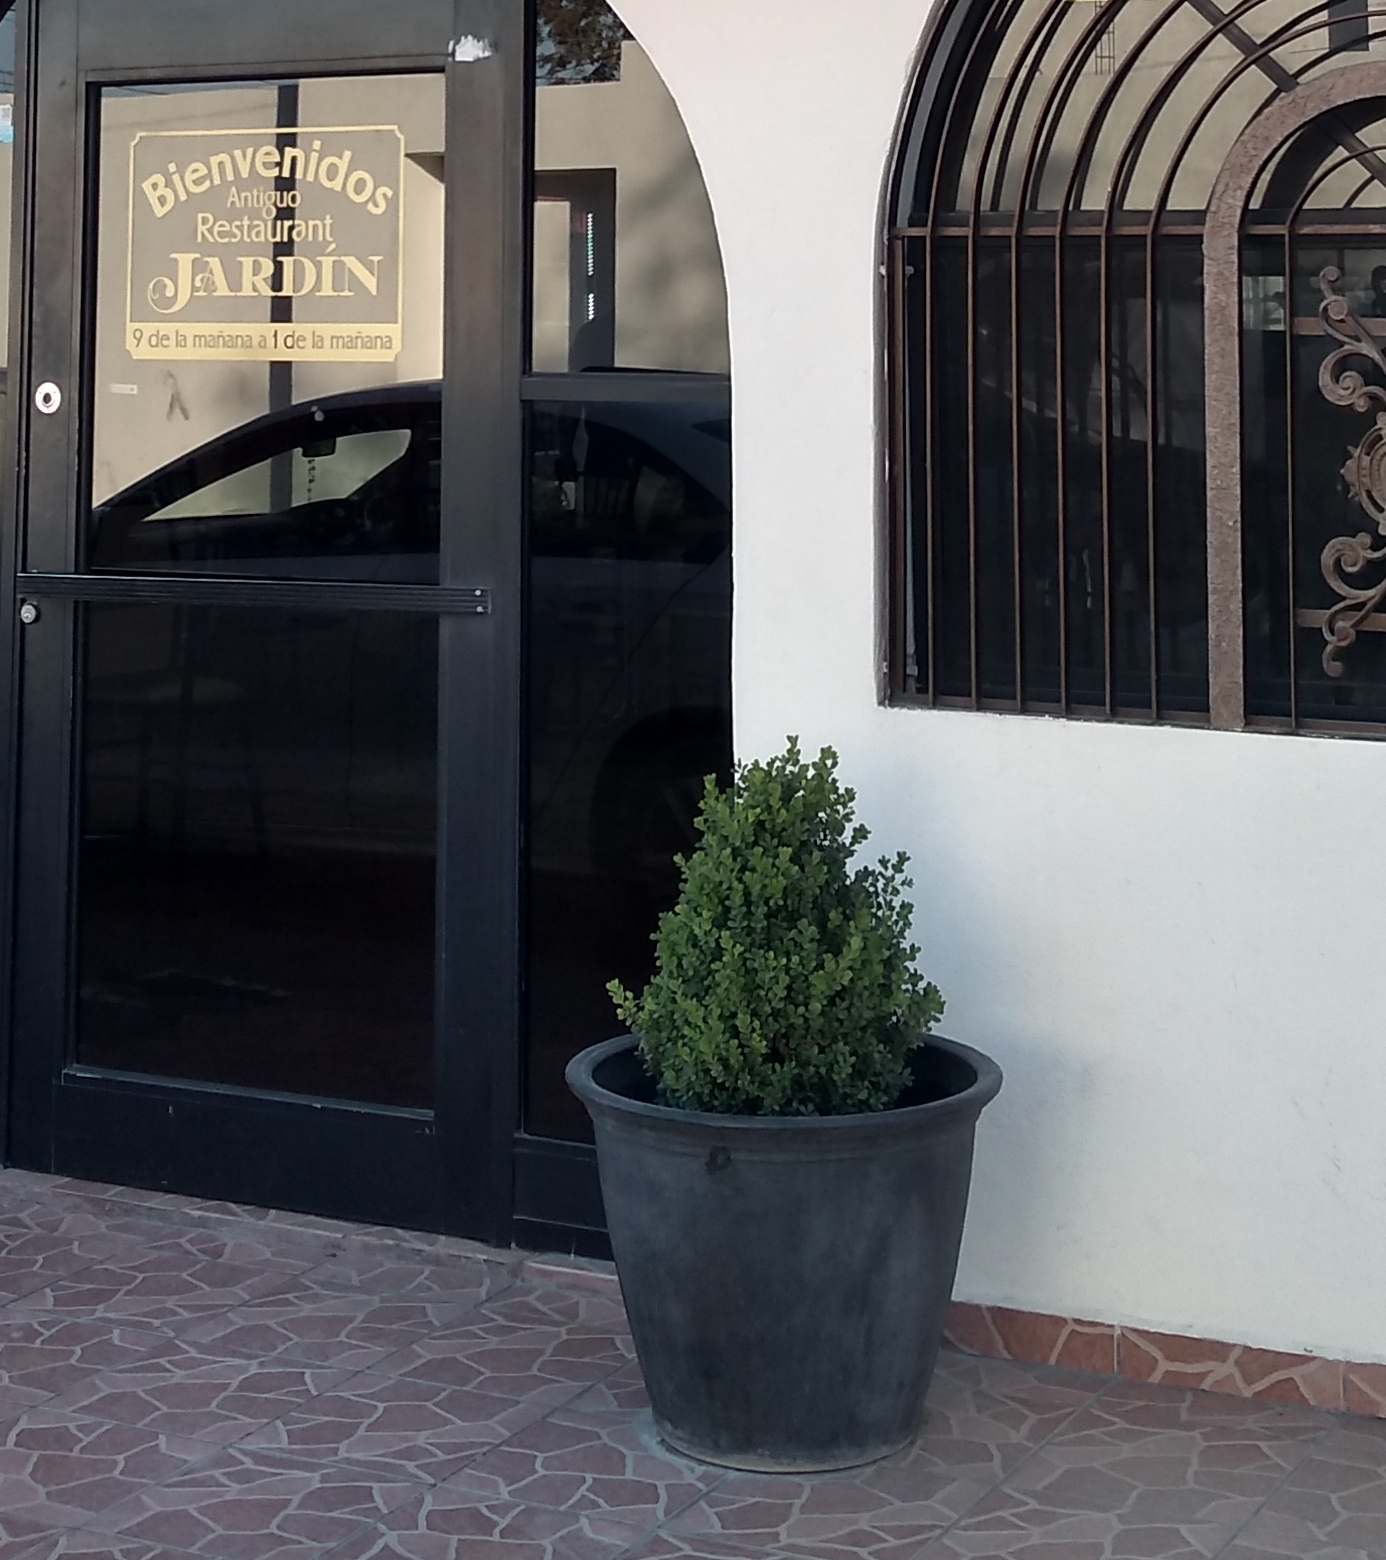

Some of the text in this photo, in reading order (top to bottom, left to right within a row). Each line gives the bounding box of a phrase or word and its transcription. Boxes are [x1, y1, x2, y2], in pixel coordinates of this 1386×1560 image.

[141, 139, 394, 218] Bienvenidos
[226, 186, 301, 220] Antiguo
[196, 212, 334, 243] Restaurant
[147, 243, 384, 314] JARDÍN
[133, 328, 393, 350] 9 de la mañana a 1 de la mañana
